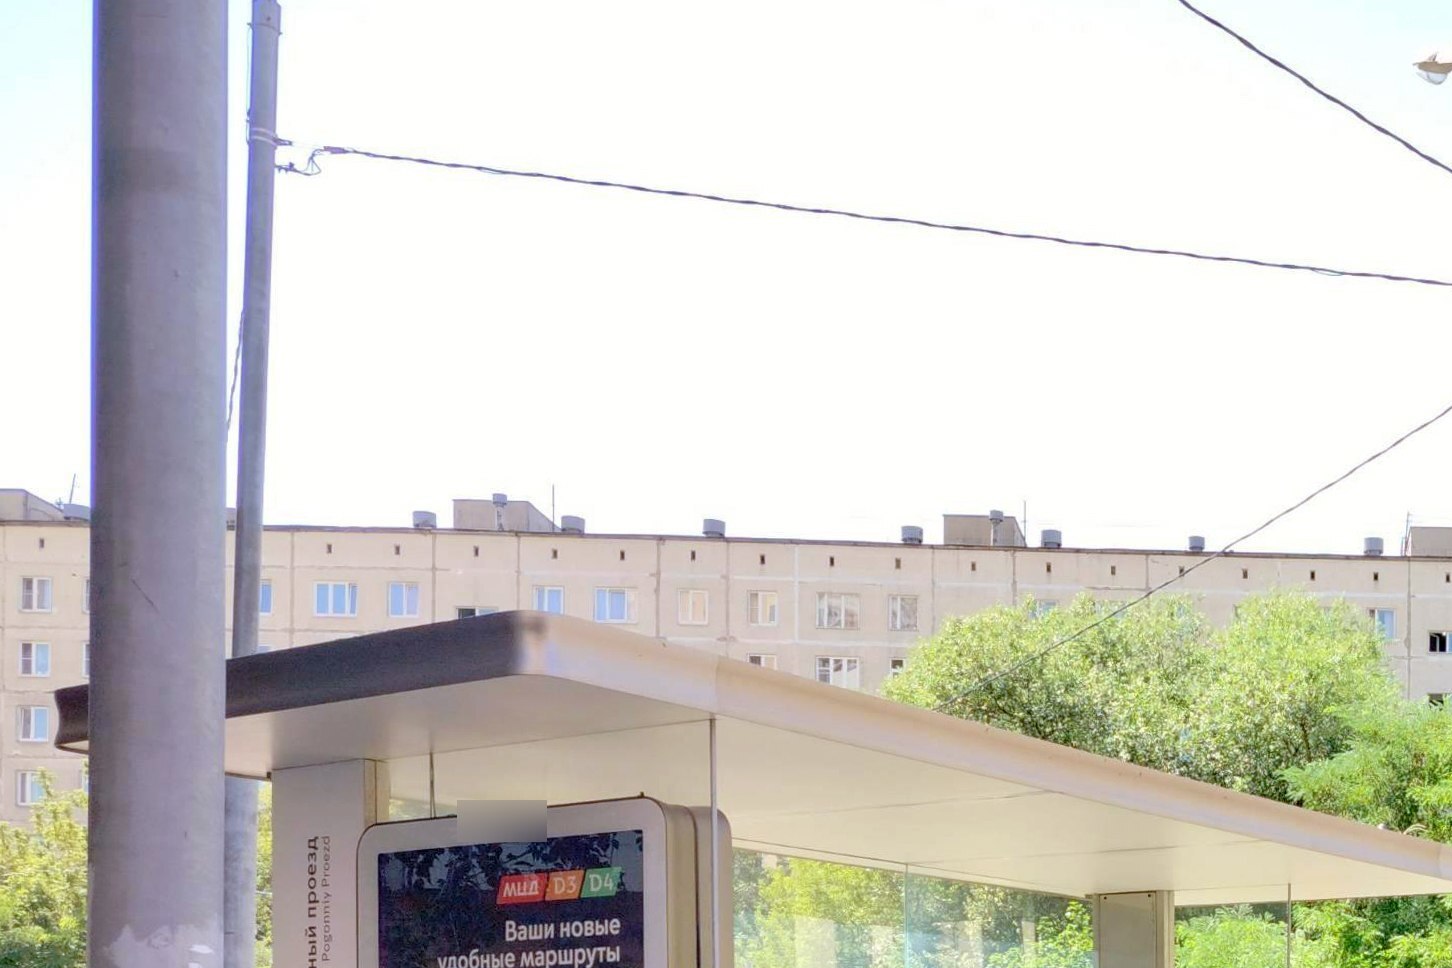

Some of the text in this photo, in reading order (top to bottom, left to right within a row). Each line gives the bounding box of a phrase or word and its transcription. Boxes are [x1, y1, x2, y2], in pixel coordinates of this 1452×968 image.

[307, 836, 319, 918] проезд
[321, 835, 333, 961] Pogonniy Proezd
[502, 873, 614, 898] МЦД D3 D4
[505, 918, 621, 942] Ваши новые
